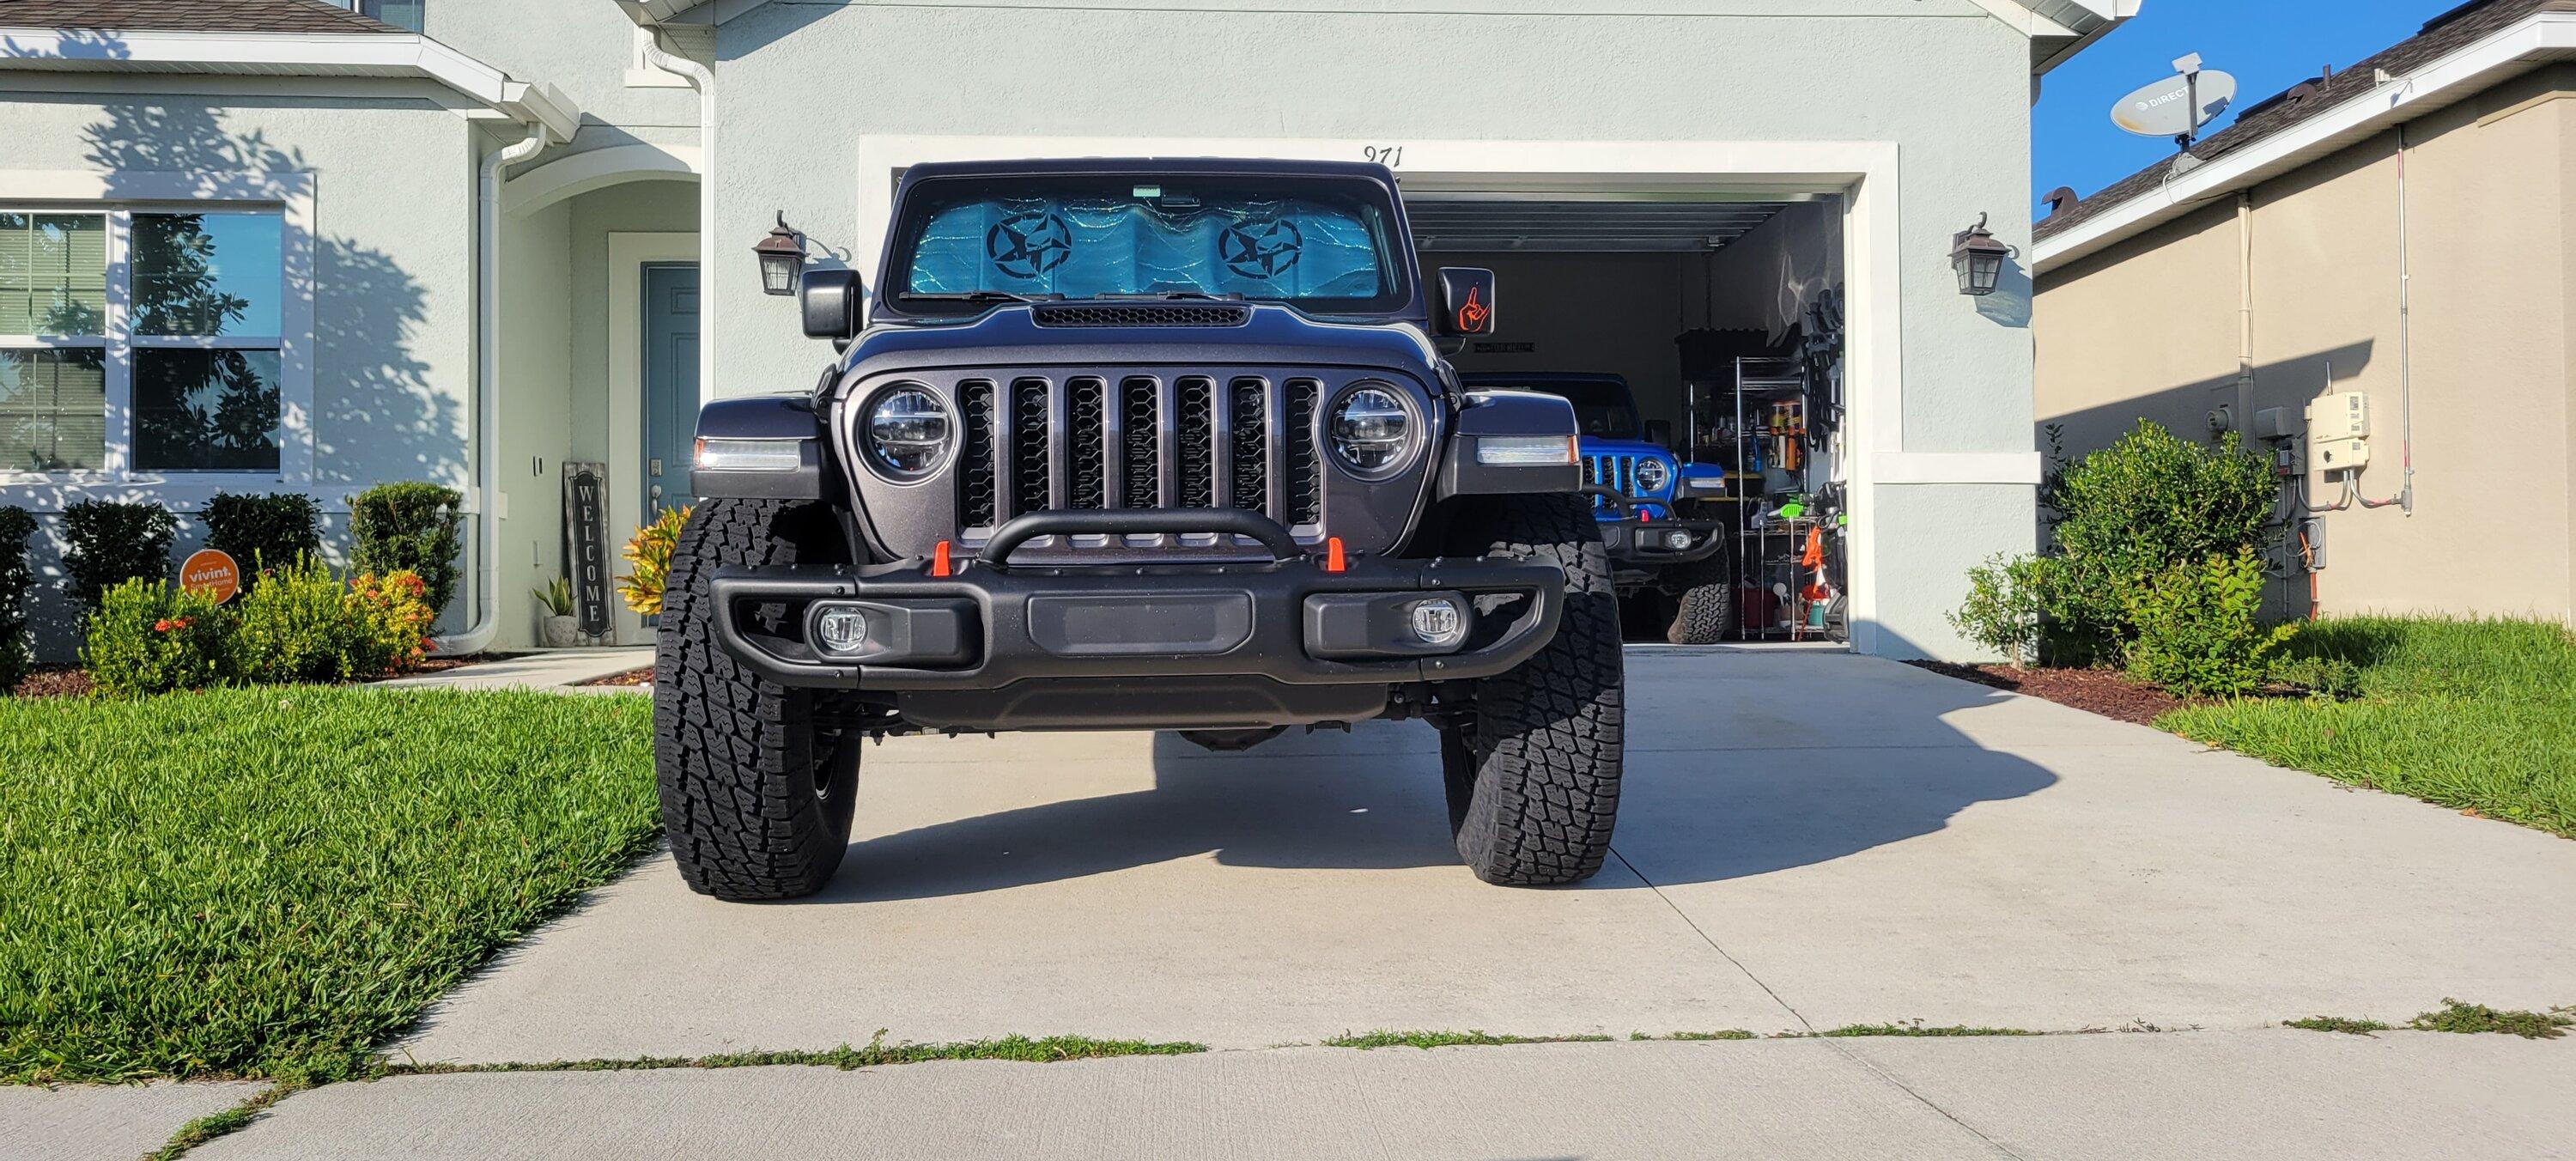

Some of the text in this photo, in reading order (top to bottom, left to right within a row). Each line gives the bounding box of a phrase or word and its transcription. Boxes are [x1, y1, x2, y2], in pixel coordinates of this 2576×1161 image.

[2148, 86, 2190, 107] DIRECT
[1364, 145, 1402, 167] 971
[579, 485, 600, 622] WELCOME
[190, 578, 233, 590] SmtHome
